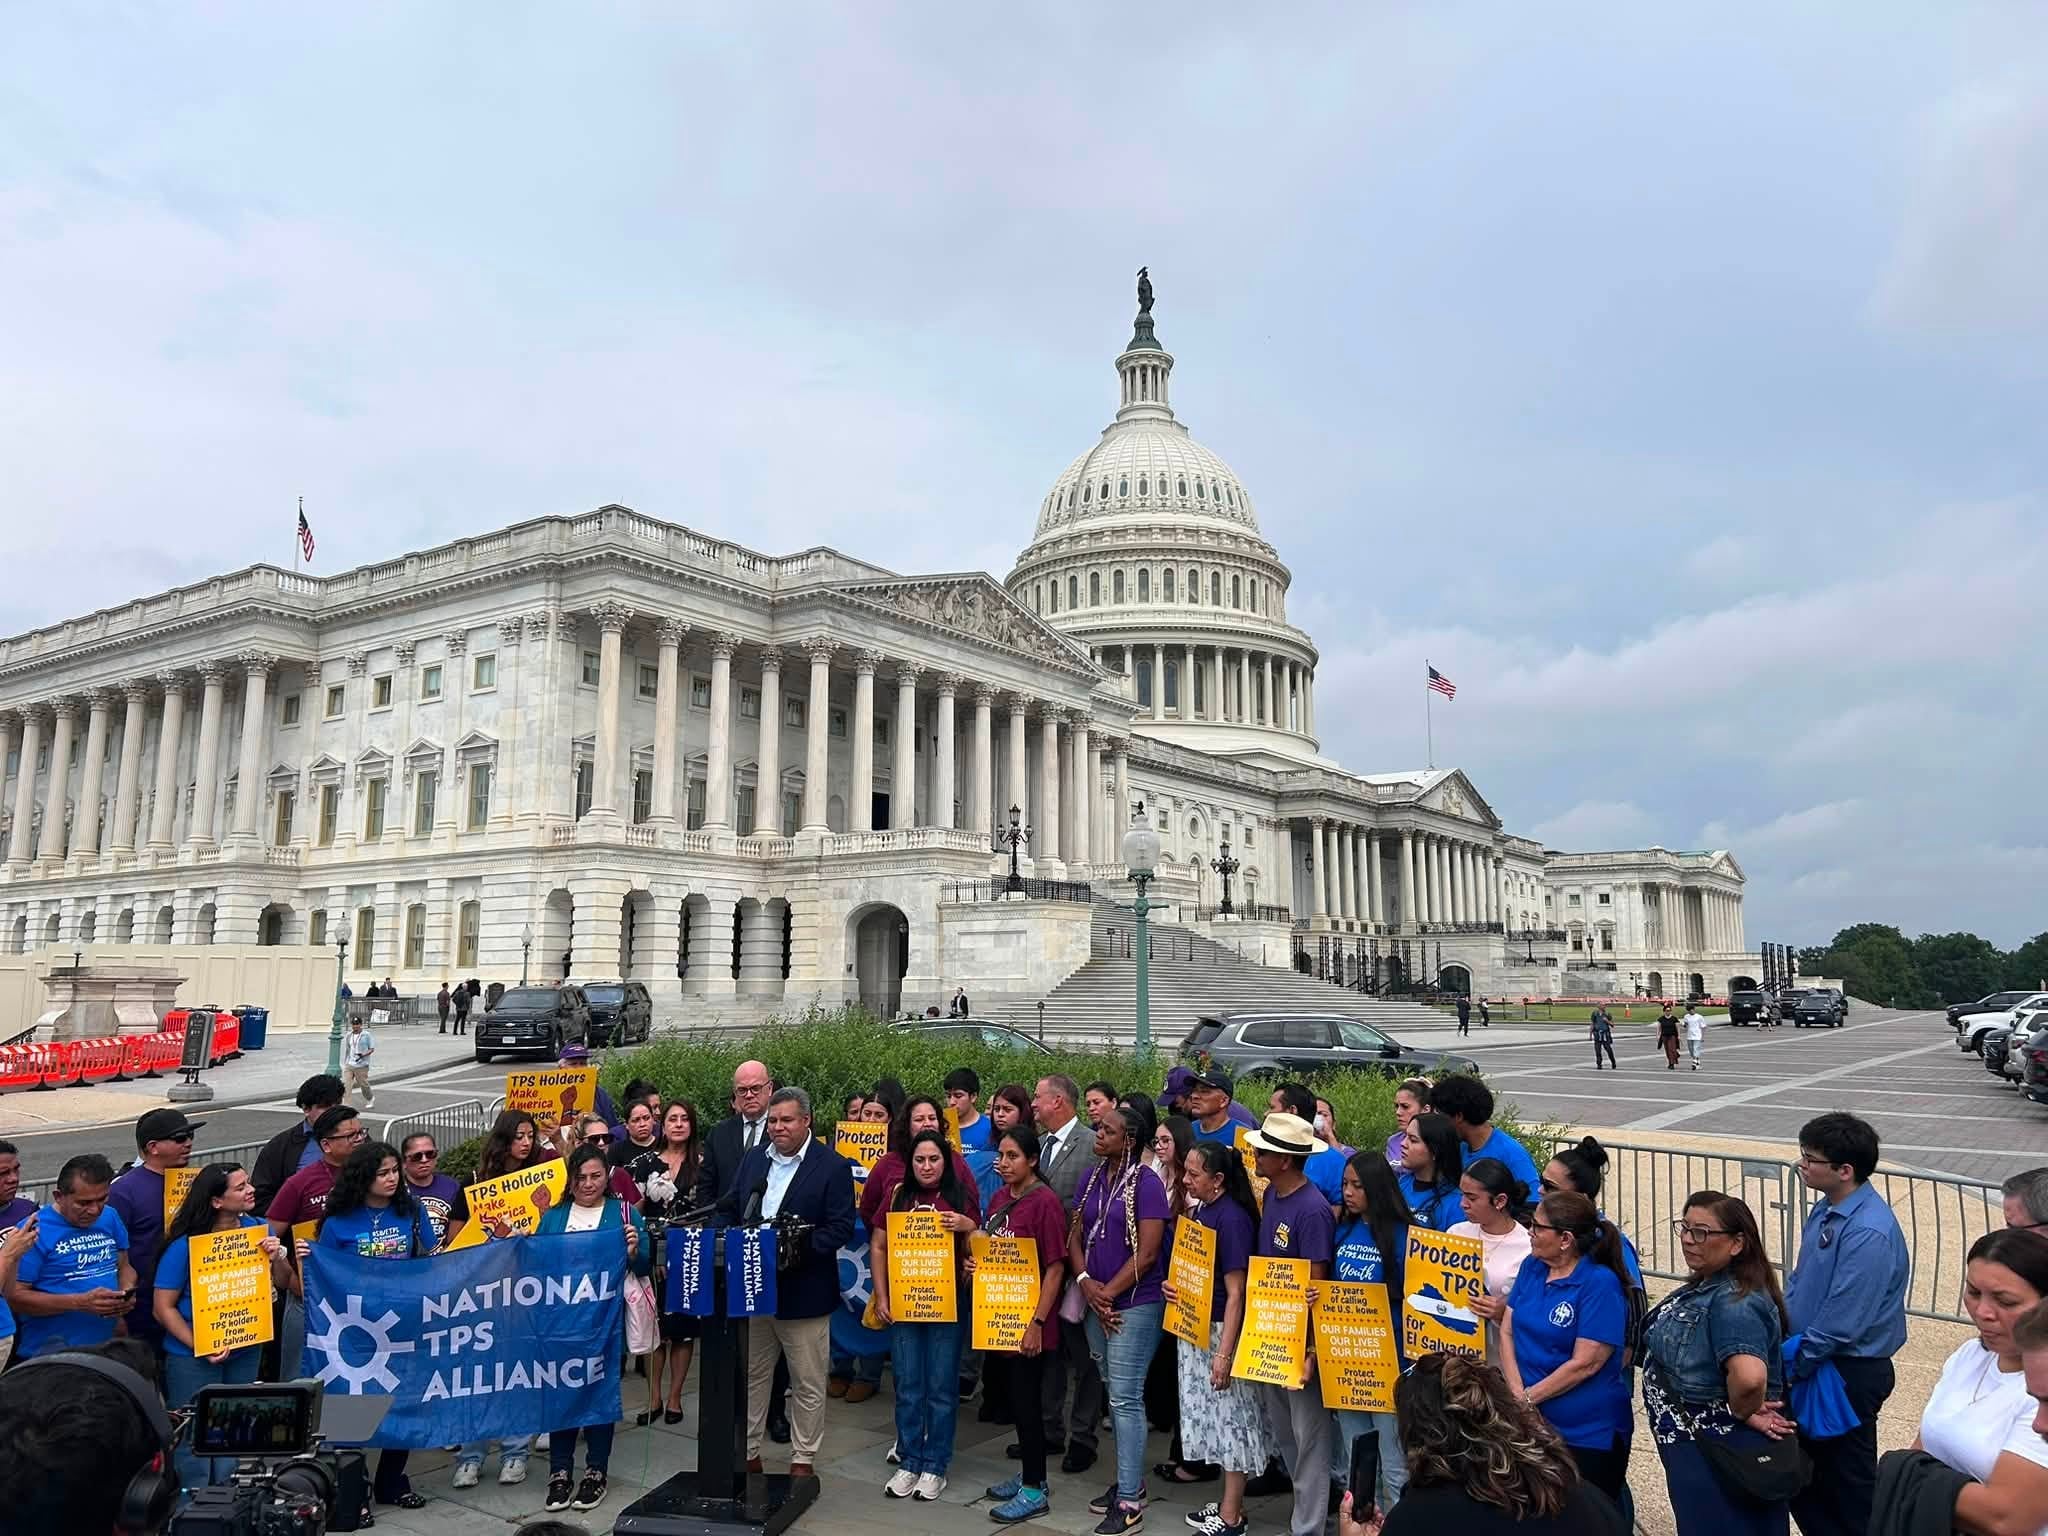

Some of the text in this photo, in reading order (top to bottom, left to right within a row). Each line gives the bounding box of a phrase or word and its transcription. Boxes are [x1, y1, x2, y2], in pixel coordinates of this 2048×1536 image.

[511, 1072, 586, 1087] TPS Holders
[509, 1088, 538, 1099] Make
[508, 1098, 554, 1110] America
[837, 1130, 885, 1145] Protect
[859, 1147, 885, 1161] TPS
[469, 1168, 554, 1202] TPS Holders
[916, 1216, 934, 1224] years
[914, 1224, 936, 1232] calling
[213, 1232, 247, 1245] 25 years
[212, 1242, 250, 1254] of calling
[1000, 1242, 1018, 1250] years
[202, 1248, 258, 1264] the U.S. home
[914, 1249, 949, 1257] FAMILIES
[998, 1250, 1020, 1258] calling
[1344, 1252, 1382, 1262] TPS ALLIAN
[1409, 1238, 1481, 1273] Protect
[690, 1240, 701, 1294] NATIONAL
[752, 1242, 763, 1294] NATIONAL
[902, 1259, 918, 1267] OUR
[1268, 1262, 1292, 1272] 25 years
[198, 1266, 264, 1284] OUR FAMILIES
[682, 1240, 692, 1310] TPS ALLIANCE
[902, 1268, 944, 1276] OUR FIGHT
[1266, 1270, 1294, 1280] of calling
[1339, 1262, 1376, 1280] Youth
[980, 1274, 1034, 1283] OUR FAMILIES
[208, 1278, 257, 1293] OUR LIVES
[744, 1262, 754, 1312] ALLIANCE
[910, 1286, 935, 1294] Protect
[986, 1284, 1028, 1294] OUR LIVES
[1258, 1280, 1300, 1290] the U.S. home
[1441, 1272, 1480, 1298] TPS
[208, 1288, 258, 1304] OUR FIGHT
[422, 1271, 616, 1323] NATIONAL
[904, 1294, 944, 1302] TPS holders
[986, 1294, 1028, 1302] OUR FIGHT
[1330, 1286, 1364, 1298] 25 years
[915, 1302, 932, 1310] from
[1252, 1299, 1303, 1312] OUR FAMILIES
[1330, 1295, 1368, 1306] of calling
[219, 1307, 250, 1320] Protect
[913, 1310, 942, 1318] Salvador
[1322, 1304, 1378, 1314] the U.S. home
[994, 1312, 1020, 1320] Protect
[1258, 1311, 1296, 1322] OUR LIVES
[210, 1314, 258, 1331] TPS holders
[1002, 1321, 1028, 1330] holders
[1256, 1322, 1296, 1334] OUR FIGHT
[225, 1327, 244, 1337] from
[998, 1329, 1016, 1338] from
[1320, 1324, 1387, 1337] OUR FAMILIES
[213, 1333, 258, 1348] El Salvador
[422, 1321, 494, 1357] TPS
[1330, 1336, 1380, 1348] OUR LIVES
[1261, 1342, 1287, 1352] Protect
[1406, 1331, 1482, 1360] El Salvador
[1251, 1349, 1293, 1364] TPS holders
[1330, 1347, 1382, 1359] OUR FIGHT
[1260, 1361, 1279, 1370] from
[422, 1354, 604, 1402] ALLIANCE
[1247, 1367, 1288, 1381] El Salvador
[1344, 1368, 1375, 1378] Protect
[1336, 1376, 1386, 1388] TPS holders
[1352, 1387, 1372, 1396] from
[1341, 1396, 1386, 1408] El Salvador
